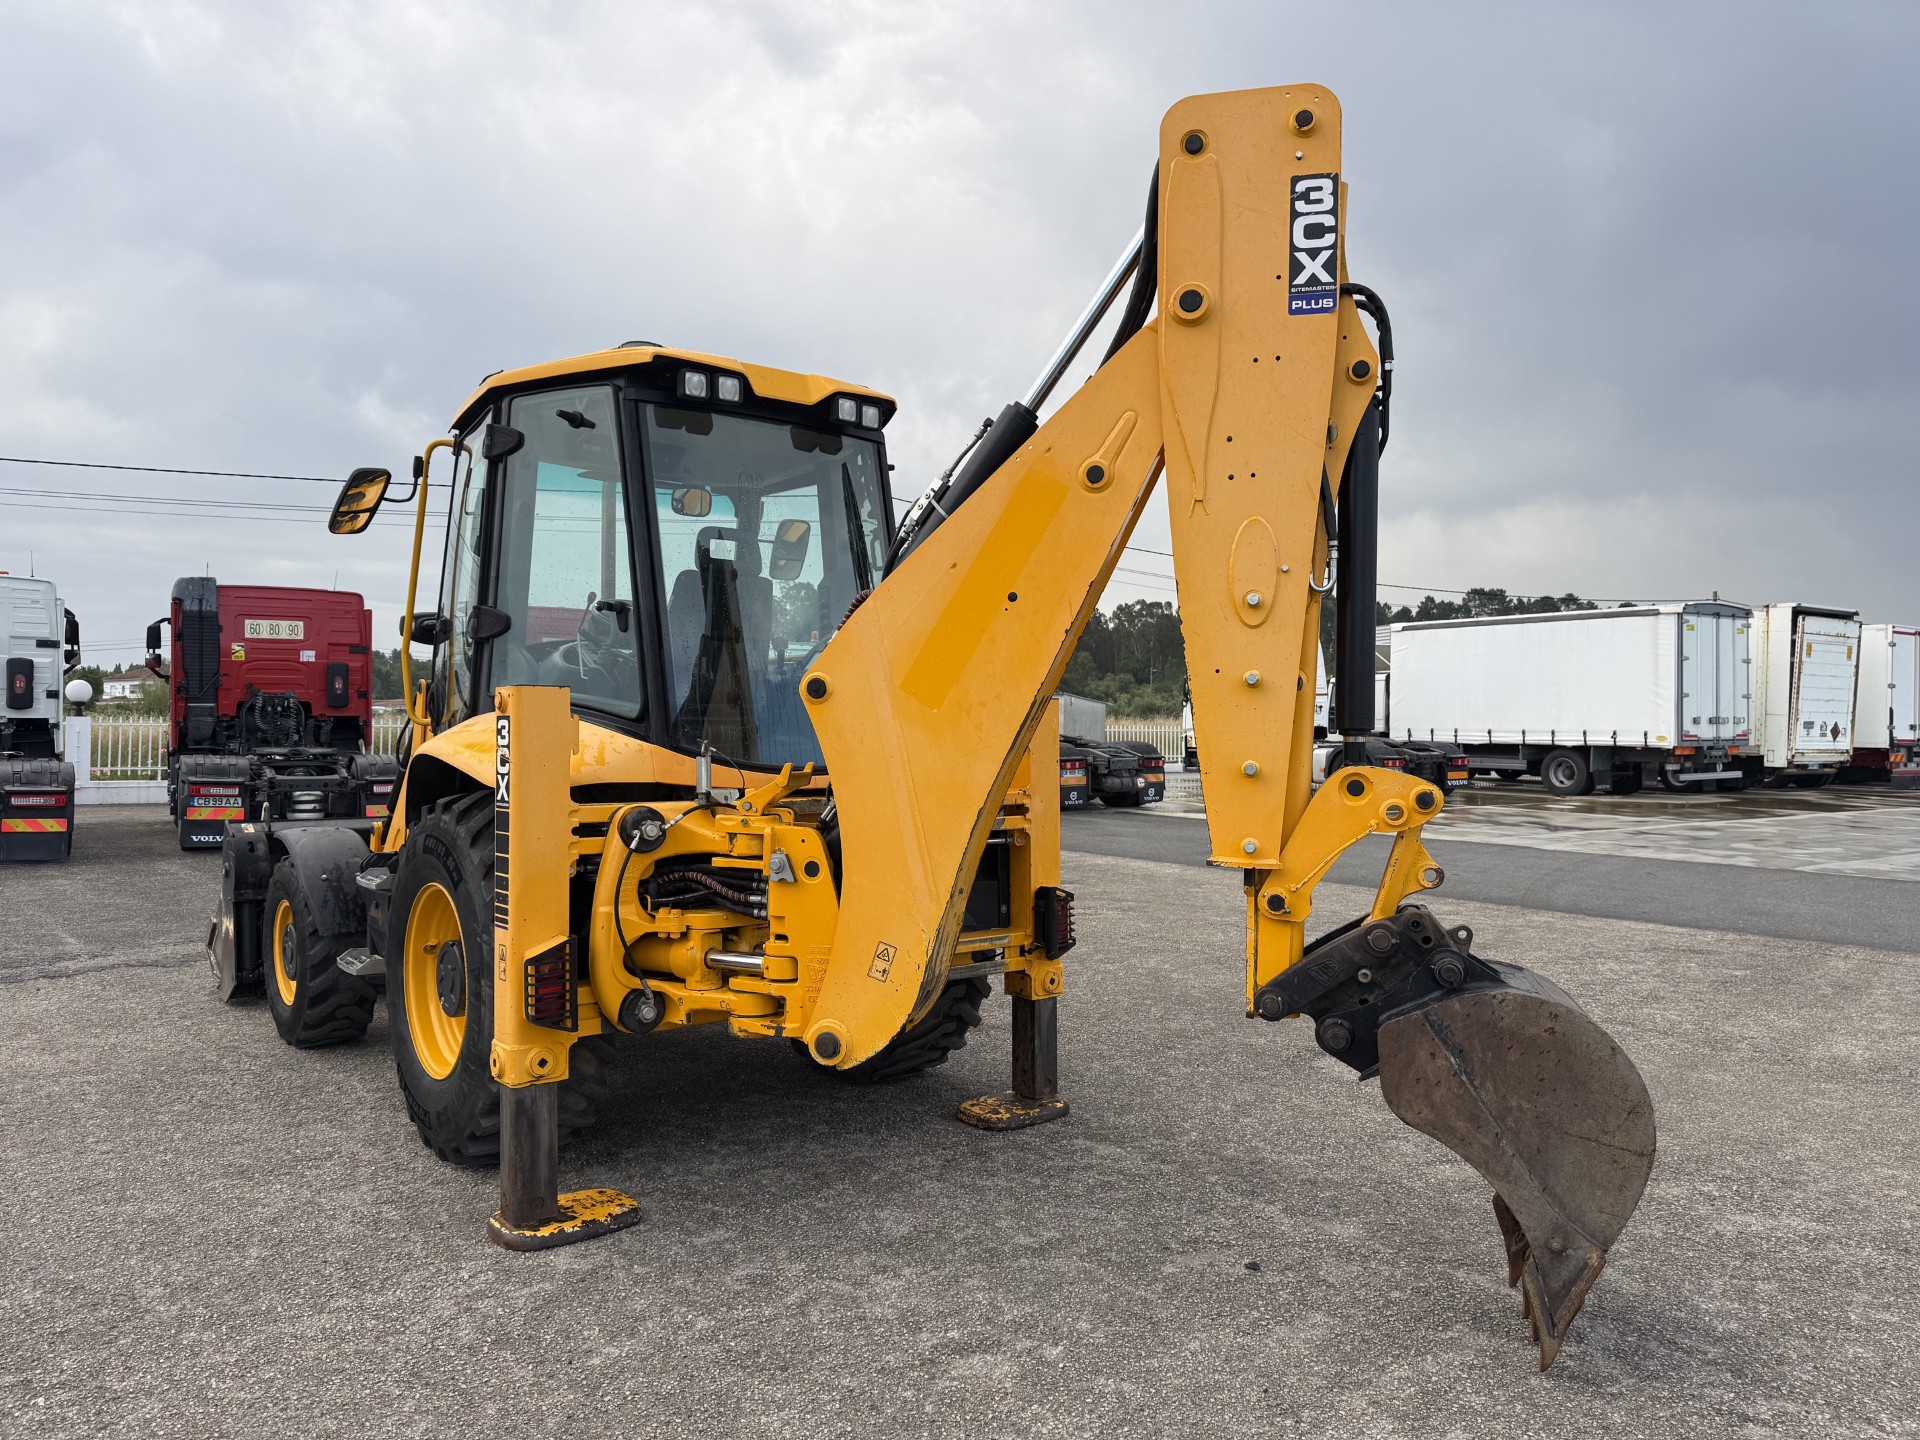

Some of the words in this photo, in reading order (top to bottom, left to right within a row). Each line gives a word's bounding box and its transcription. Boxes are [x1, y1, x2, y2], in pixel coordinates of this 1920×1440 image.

[1292, 178, 1336, 285] 3CX
[1291, 285, 1335, 293] SITEMASTER
[1291, 298, 1334, 310] PLUS
[249, 623, 261, 635] 60
[268, 623, 280, 636] 80
[288, 624, 299, 637] 90
[496, 719, 510, 802] 3CX
